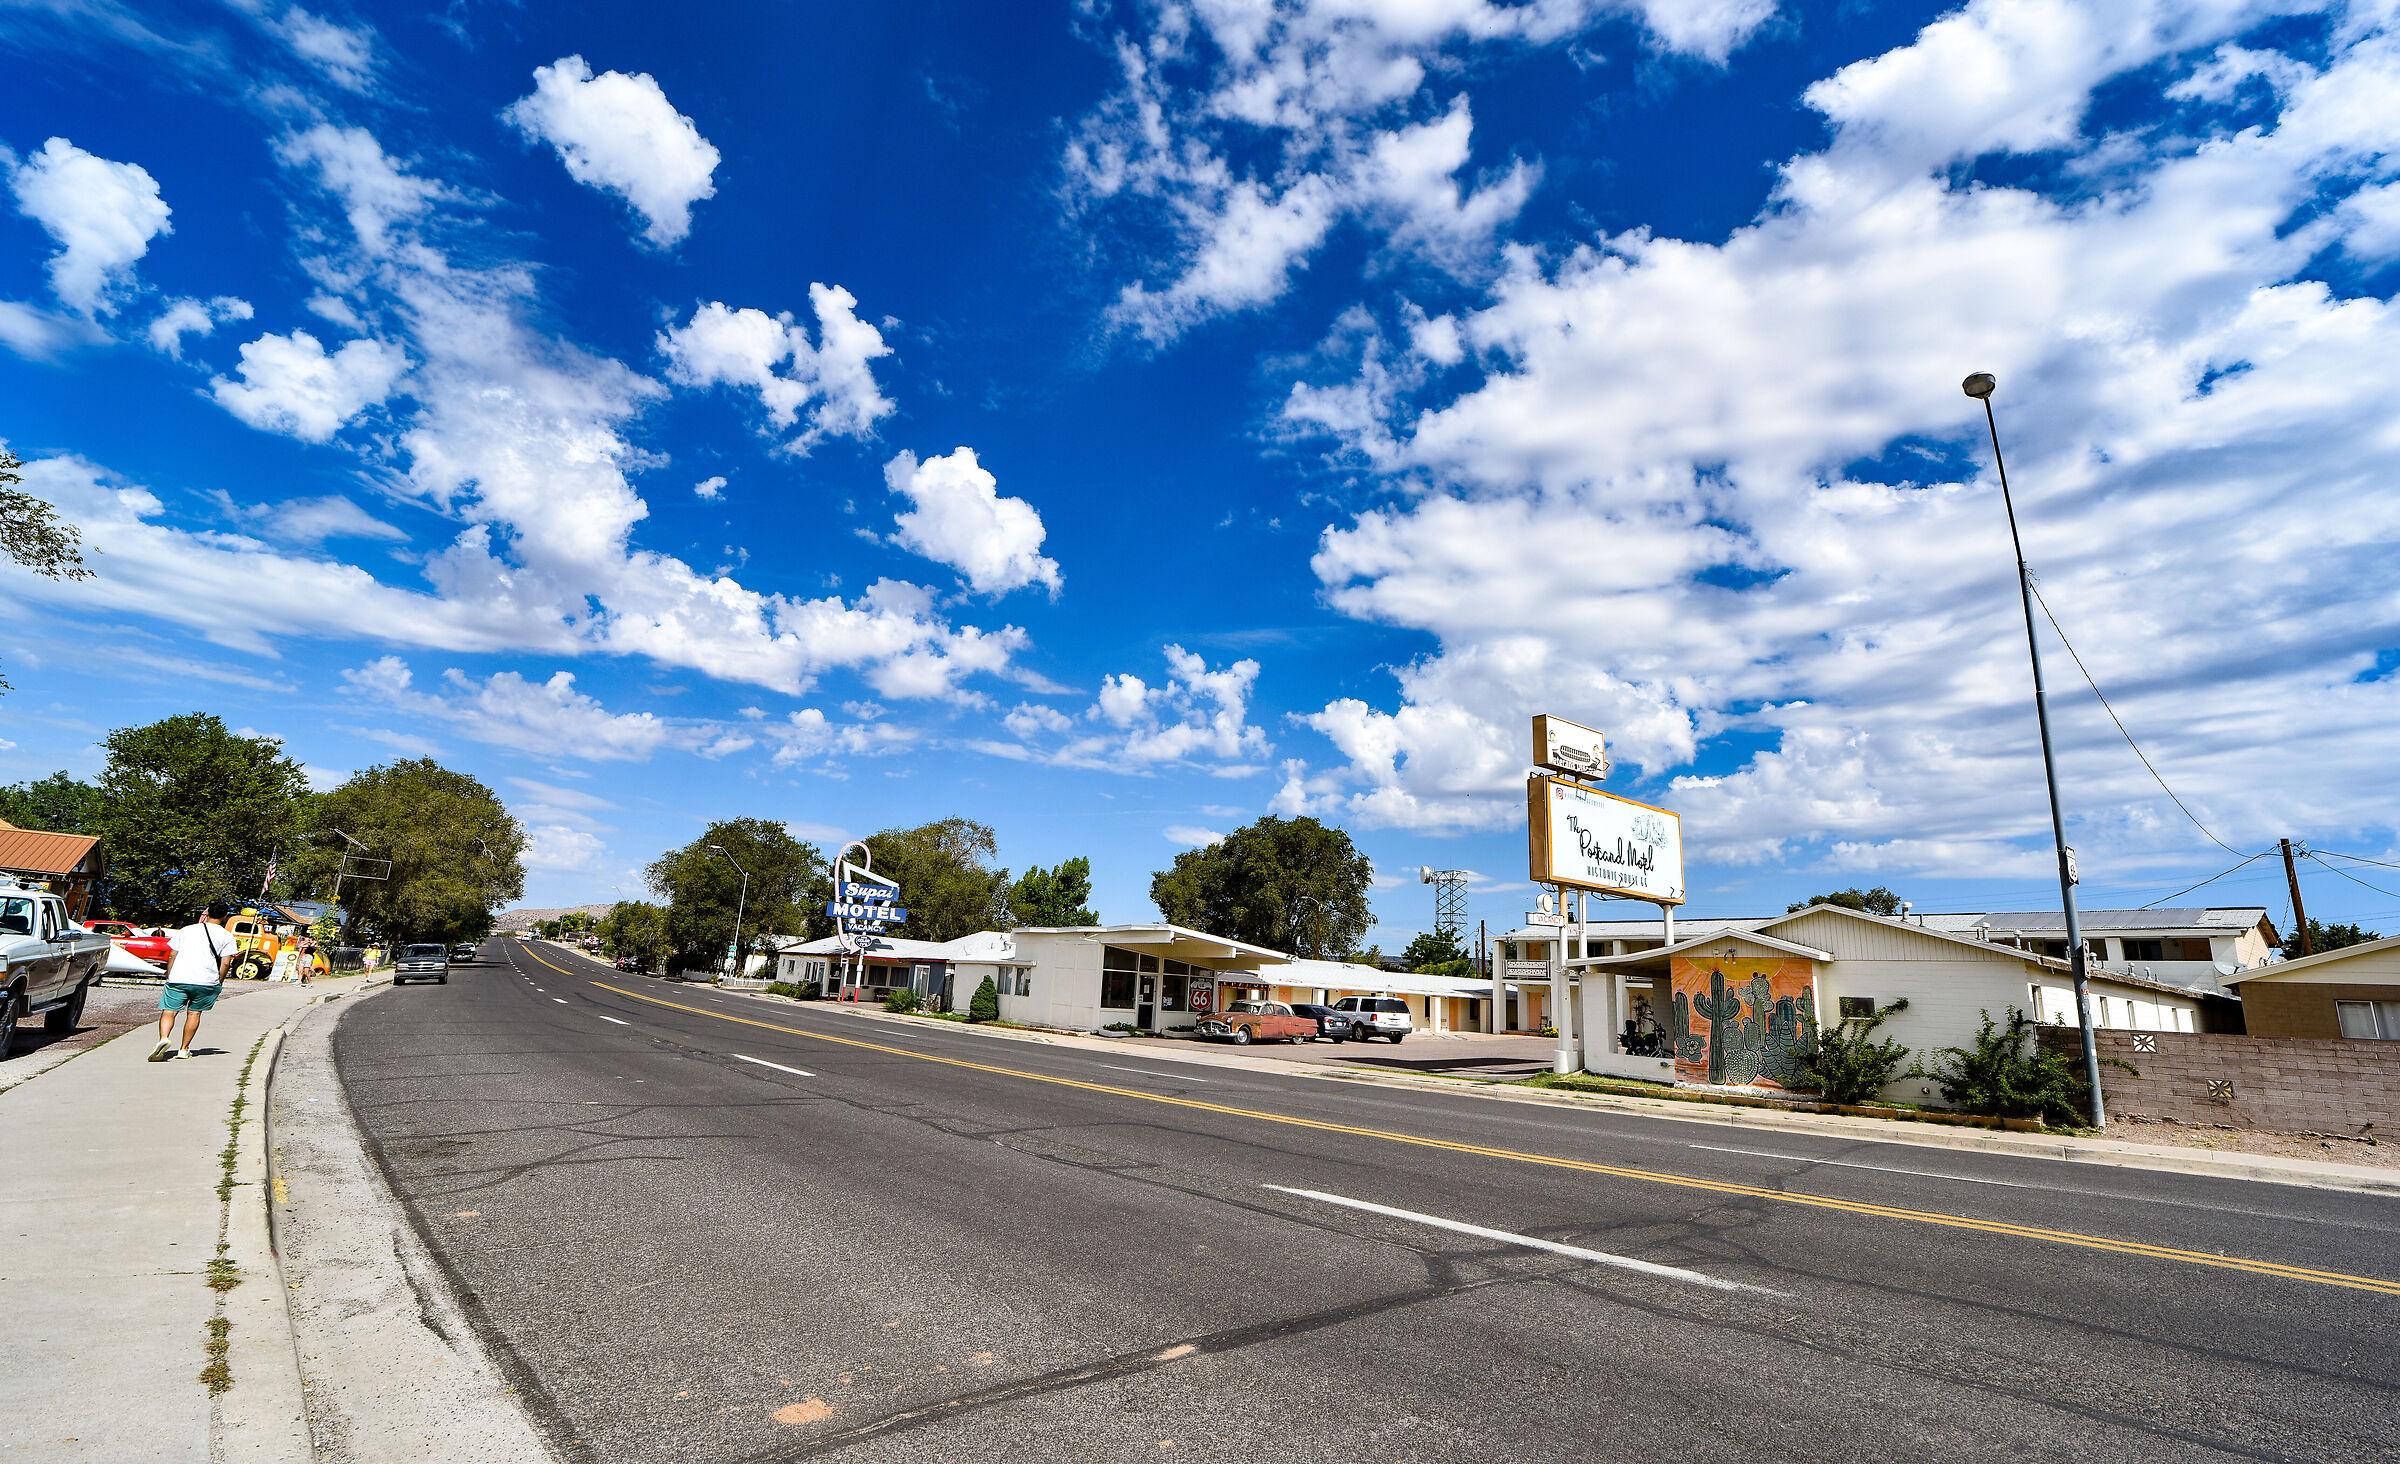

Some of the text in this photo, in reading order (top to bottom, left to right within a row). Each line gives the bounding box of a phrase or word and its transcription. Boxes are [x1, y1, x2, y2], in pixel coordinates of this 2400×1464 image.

[1566, 814, 1582, 834] The
[1579, 828, 1654, 875] Postcard Motel
[1587, 865, 1618, 882] HISTORIC
[845, 883, 893, 902] Supai
[833, 903, 901, 920] MOTEL
[1537, 915, 1561, 924] VACANCY
[848, 924, 884, 932] VACANCY
[1193, 991, 1207, 1005] 66
